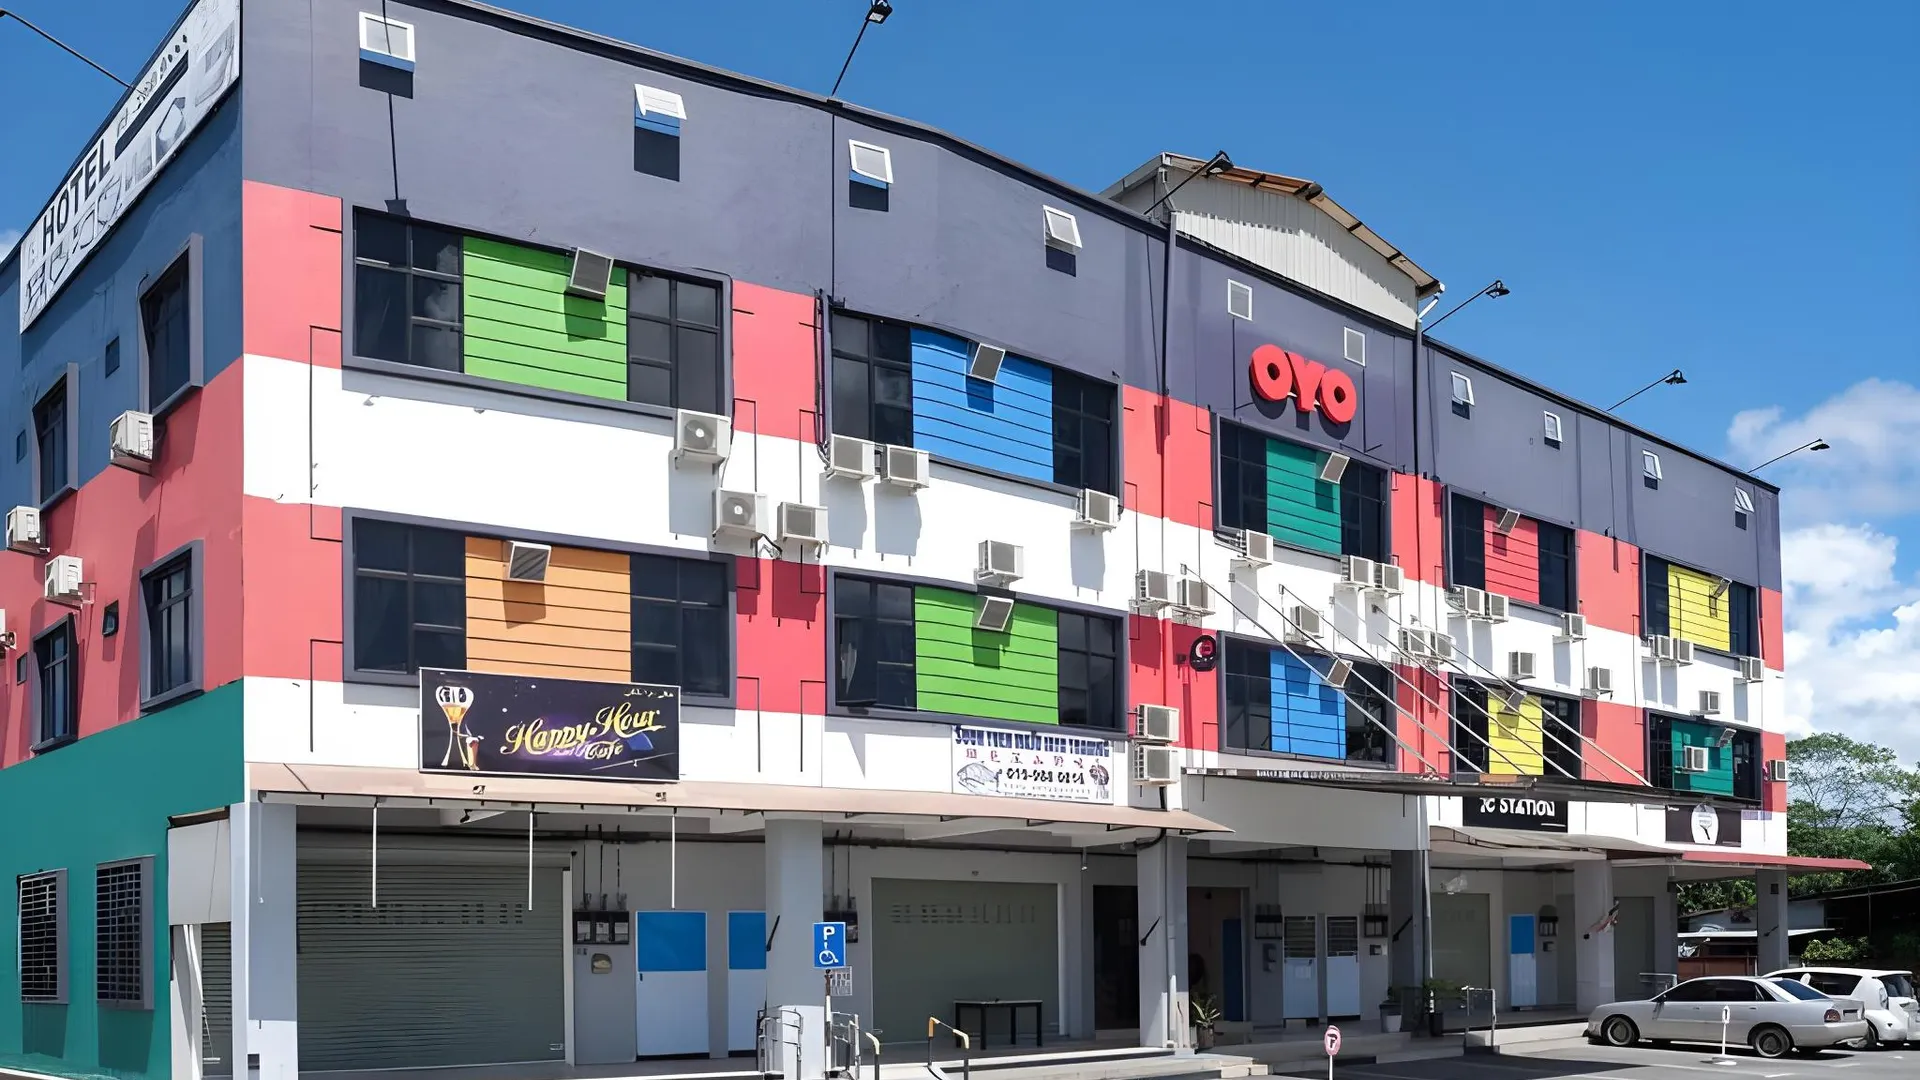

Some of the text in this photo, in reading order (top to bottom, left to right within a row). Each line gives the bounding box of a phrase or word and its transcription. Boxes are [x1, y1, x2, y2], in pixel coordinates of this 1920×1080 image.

[42, 137, 111, 255] HOTEL
[1249, 343, 1357, 425] OYO
[1500, 797, 1555, 816] STATION
[823, 926, 835, 941] P
